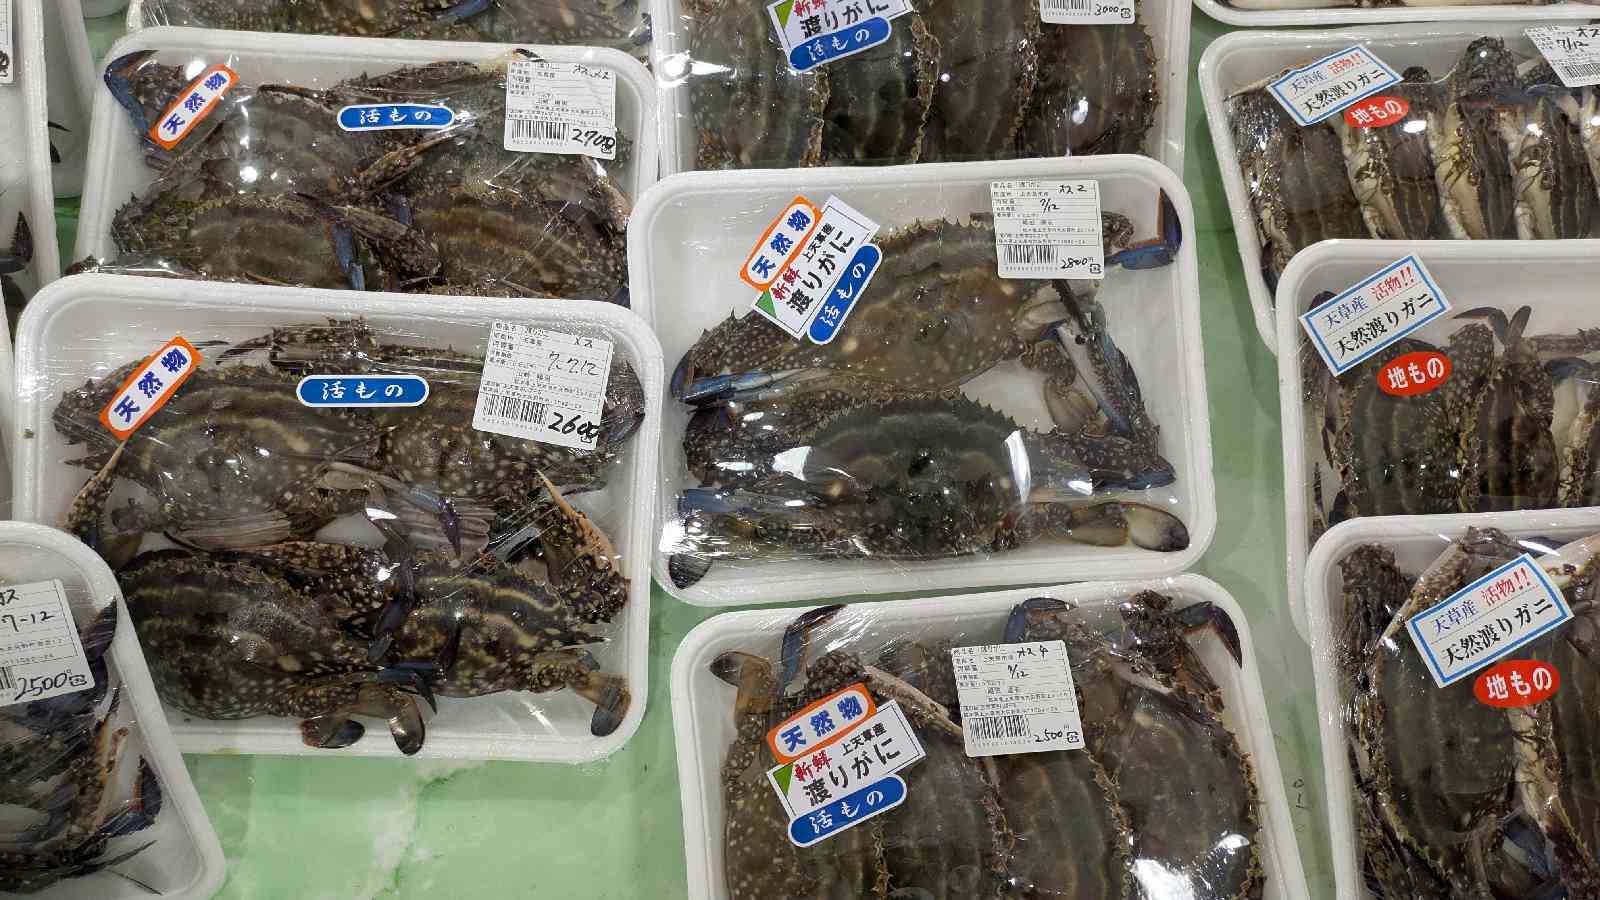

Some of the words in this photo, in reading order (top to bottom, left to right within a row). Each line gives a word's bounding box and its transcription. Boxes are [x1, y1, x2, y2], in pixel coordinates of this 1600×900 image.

[806, 28, 870, 61] 活もの
[162, 72, 227, 136] 天然物
[359, 108, 432, 125] 活もの
[1303, 69, 1385, 116] 天然渡りガニ
[1352, 100, 1403, 124] 地もの
[751, 209, 811, 279] 天然物
[770, 267, 802, 301] 新鮮
[802, 223, 835, 263] 上天草産
[786, 230, 855, 316] 渡りがに
[818, 262, 866, 328] 活もの
[1324, 295, 1369, 330] 天草産
[1335, 293, 1434, 360] 天然渡りガニ
[113, 347, 189, 423] 天然物
[321, 380, 404, 401] 活もの
[1387, 357, 1444, 390] 地もの
[1433, 600, 1478, 637] 天草産
[1481, 567, 1532, 607] 活物!!
[1442, 598, 1553, 668] 天然渡りガニ
[1486, 667, 1552, 700] 地もの
[780, 695, 863, 753] 天然物
[793, 750, 833, 782] 新鮮
[841, 722, 887, 756] 上天草産
[802, 737, 900, 807] 渡りがに
[809, 790, 884, 834] 活もの
